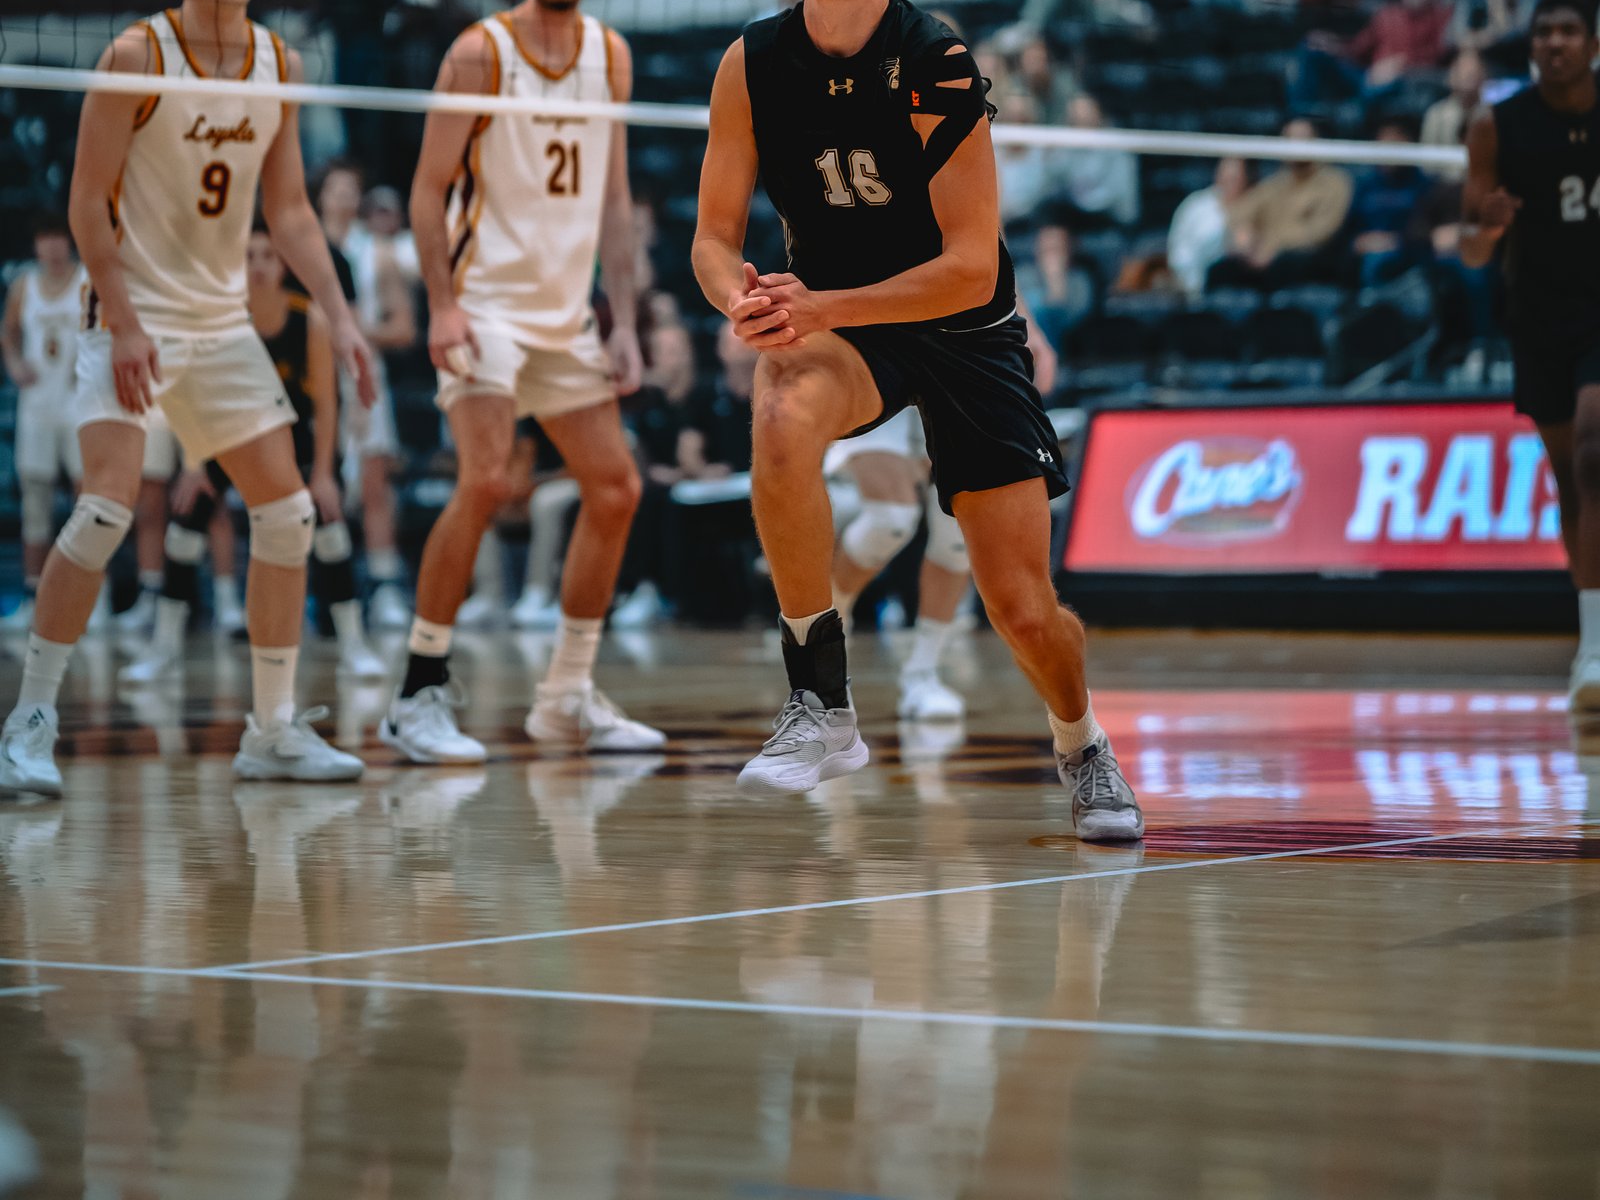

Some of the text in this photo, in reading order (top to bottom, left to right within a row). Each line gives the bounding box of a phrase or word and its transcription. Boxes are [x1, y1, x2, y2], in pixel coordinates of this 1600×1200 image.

[183, 113, 256, 150] Loyola
[197, 161, 231, 218] 9
[544, 140, 581, 197] 21
[815, 148, 892, 208] 16
[1345, 434, 1560, 541] RAI
